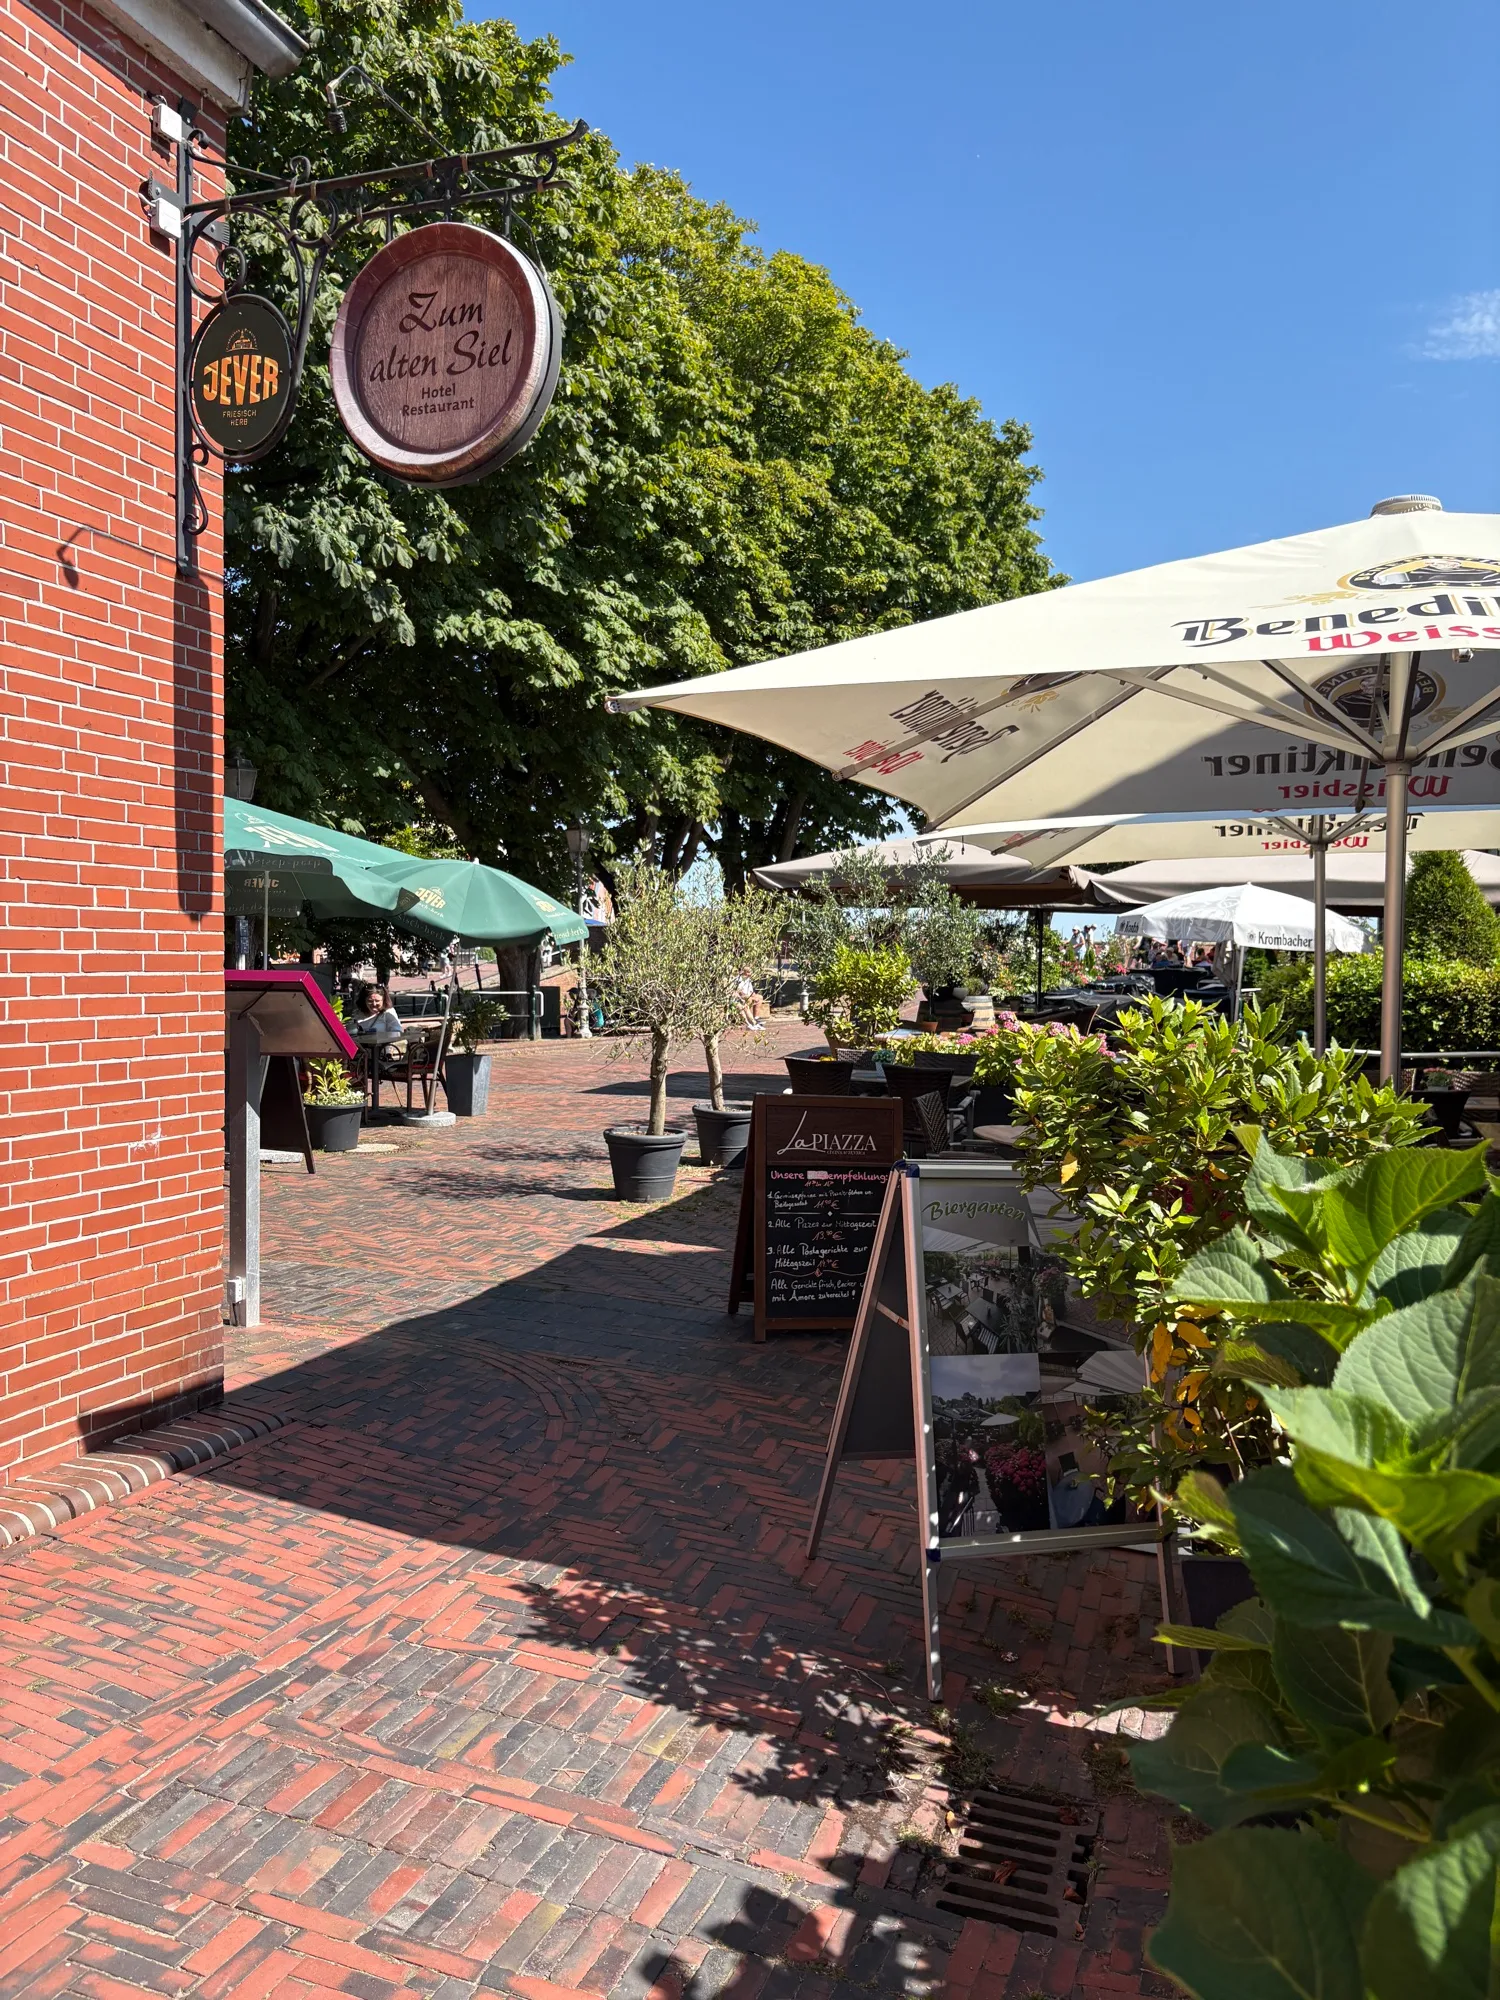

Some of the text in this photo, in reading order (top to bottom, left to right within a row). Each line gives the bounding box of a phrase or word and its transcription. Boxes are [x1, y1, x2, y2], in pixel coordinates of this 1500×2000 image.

[399, 291, 483, 333] Zum
[369, 329, 512, 383] alten Siel
[203, 354, 279, 406] JEVER
[421, 383, 456, 399] Hotel
[223, 409, 257, 418] FRIESISCH
[402, 397, 475, 417] Restaurant
[230, 418, 248, 426] HERB
[1170, 594, 1500, 647] Benedi
[415, 887, 446, 909] JEVER
[1258, 931, 1313, 948] Krombacher
[812, 1133, 877, 1151] PIAZZA
[770, 1170, 805, 1180] Unsere
[921, 1201, 1025, 1221] Biergarten
[775, 1258, 815, 1270] Mittagszeit
[770, 1278, 788, 1290] Alle
[791, 1280, 817, 1289] Gerichte
[771, 1294, 785, 1302] mit
[788, 1289, 816, 1301] Amore
